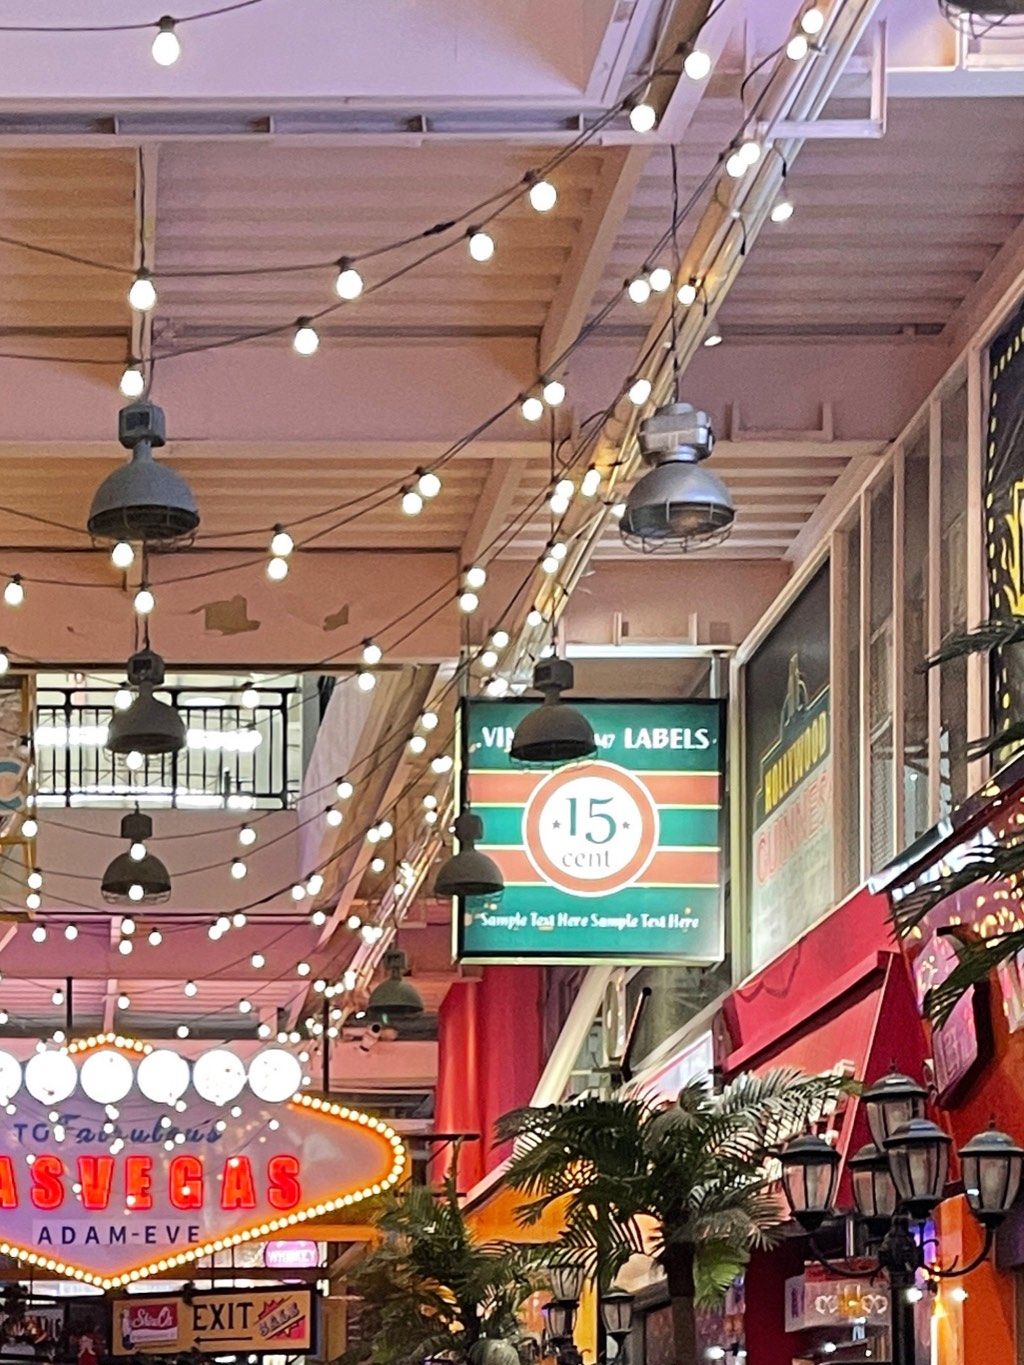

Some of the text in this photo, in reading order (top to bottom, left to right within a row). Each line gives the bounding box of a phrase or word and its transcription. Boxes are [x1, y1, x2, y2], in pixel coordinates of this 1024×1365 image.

[623, 727, 710, 750] LABELS
[565, 797, 617, 845] 15
[562, 850, 611, 868] cent
[480, 911, 528, 931] Sample
[557, 912, 588, 928] Here
[590, 912, 639, 931] Sample
[668, 913, 700, 929] Here
[36, 1225, 201, 1246] ADAM-EVE
[192, 1301, 254, 1331] EXIT
